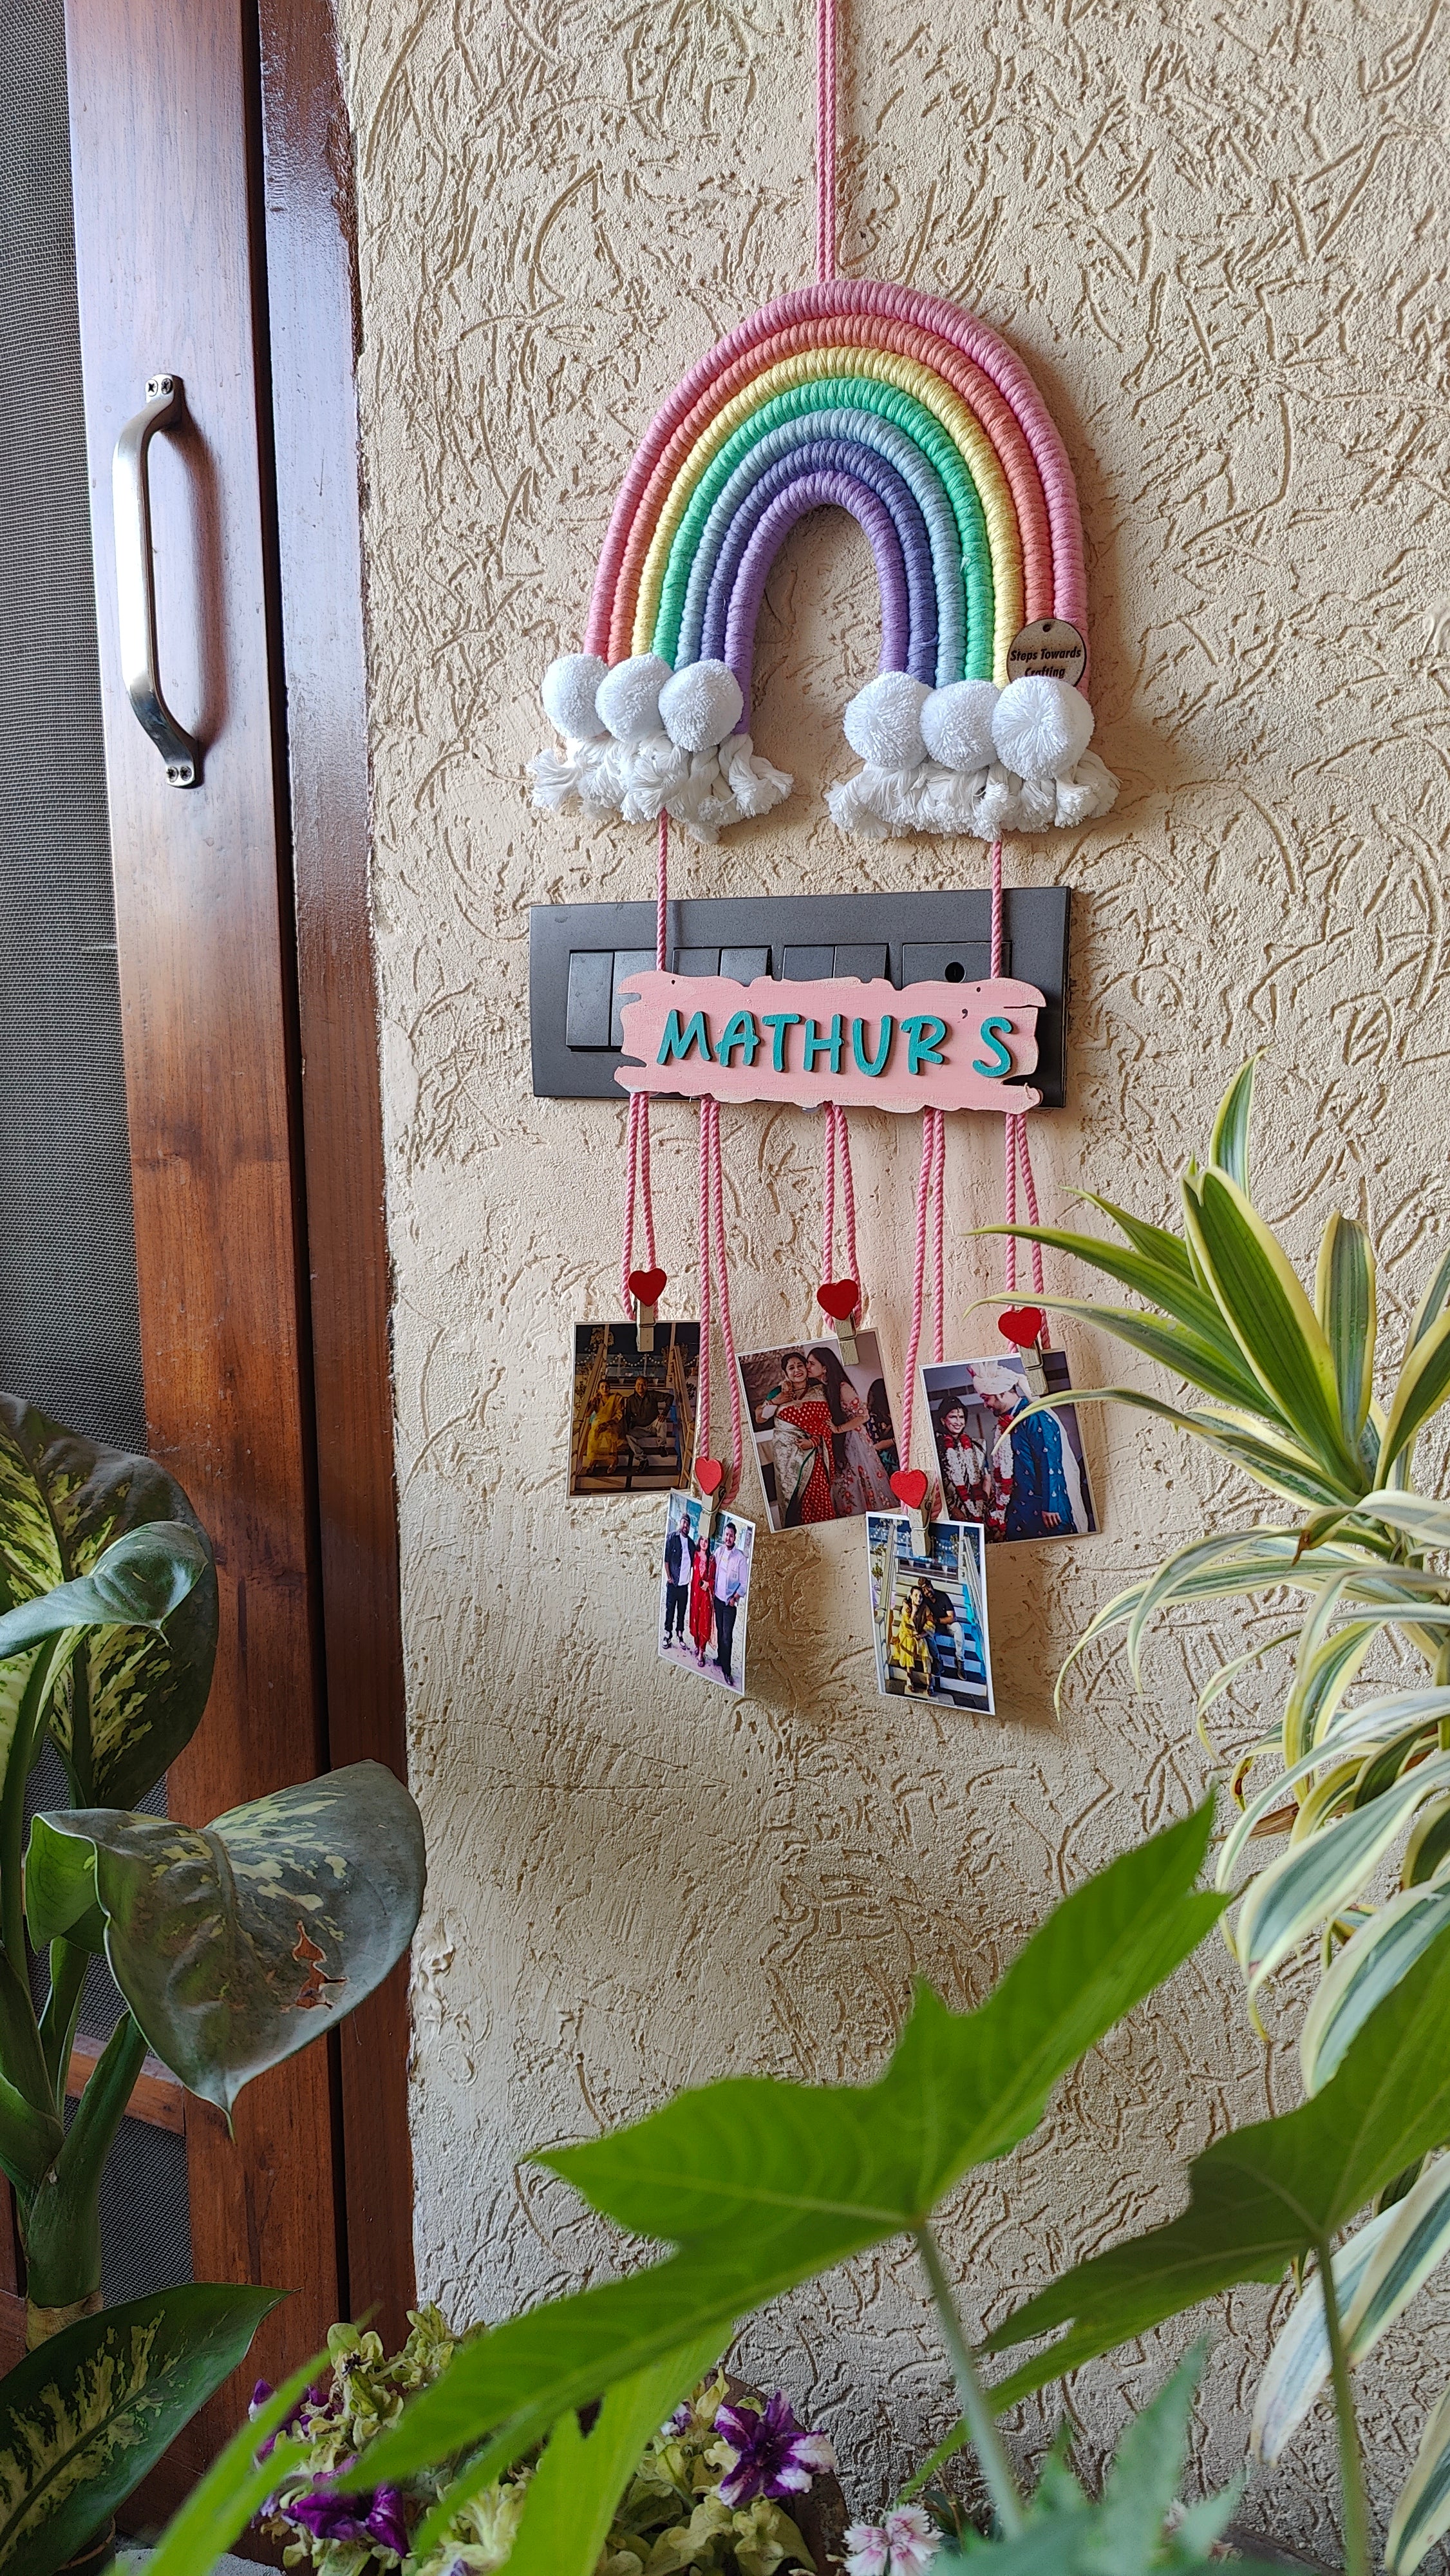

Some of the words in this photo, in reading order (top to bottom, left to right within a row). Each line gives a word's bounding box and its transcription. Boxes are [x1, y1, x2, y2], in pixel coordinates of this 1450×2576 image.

[1010, 649, 1038, 663] Steps
[1040, 647, 1081, 660] Towards
[657, 1009, 1013, 1077] MATHUR'S
